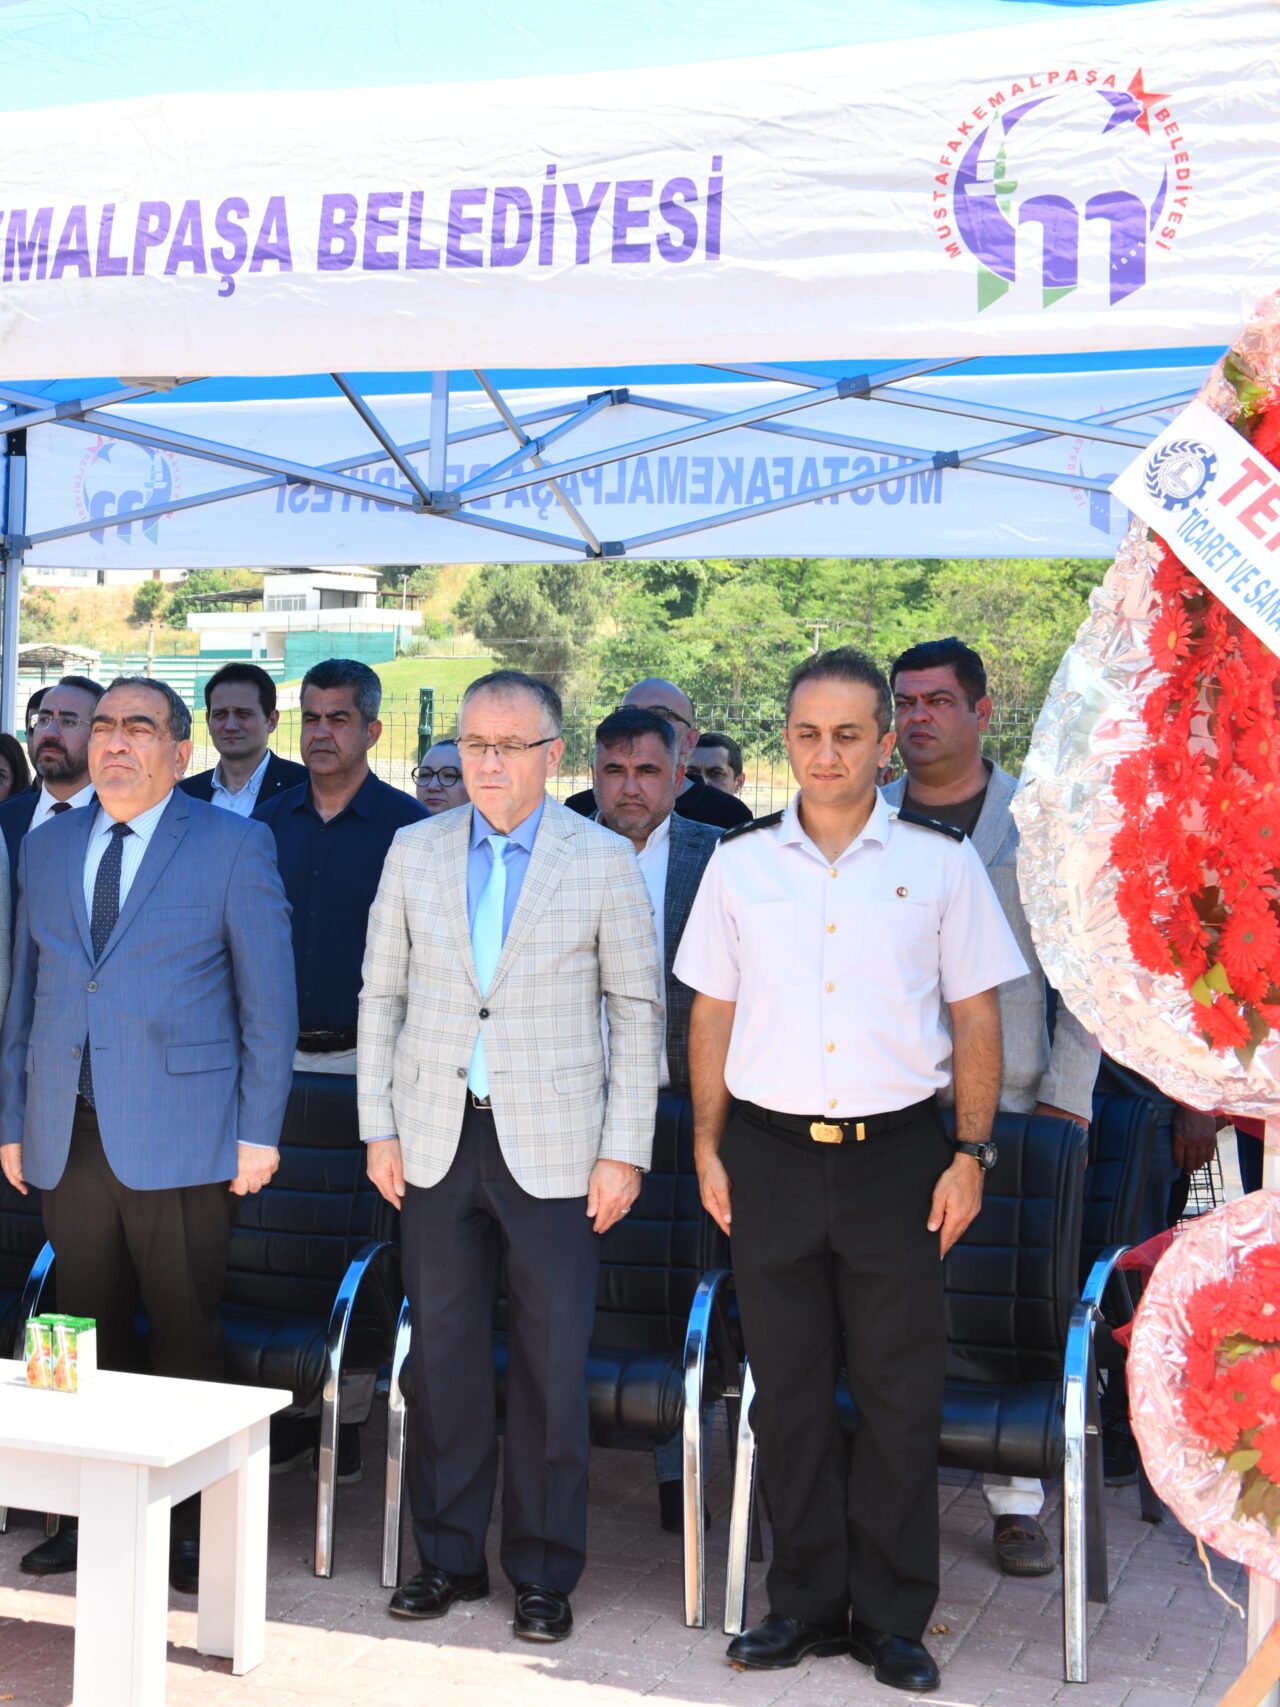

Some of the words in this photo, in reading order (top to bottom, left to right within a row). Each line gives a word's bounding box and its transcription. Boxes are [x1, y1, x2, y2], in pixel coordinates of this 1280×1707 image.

[317, 154, 724, 271] BELEDİYESİ
[933, 69, 1117, 259] MUSTAFAKEMALPAŞA
[1154, 108, 1193, 251] BELEDİYESİ
[1176, 507, 1242, 573] TİCARET
[1224, 558, 1261, 594] VE
